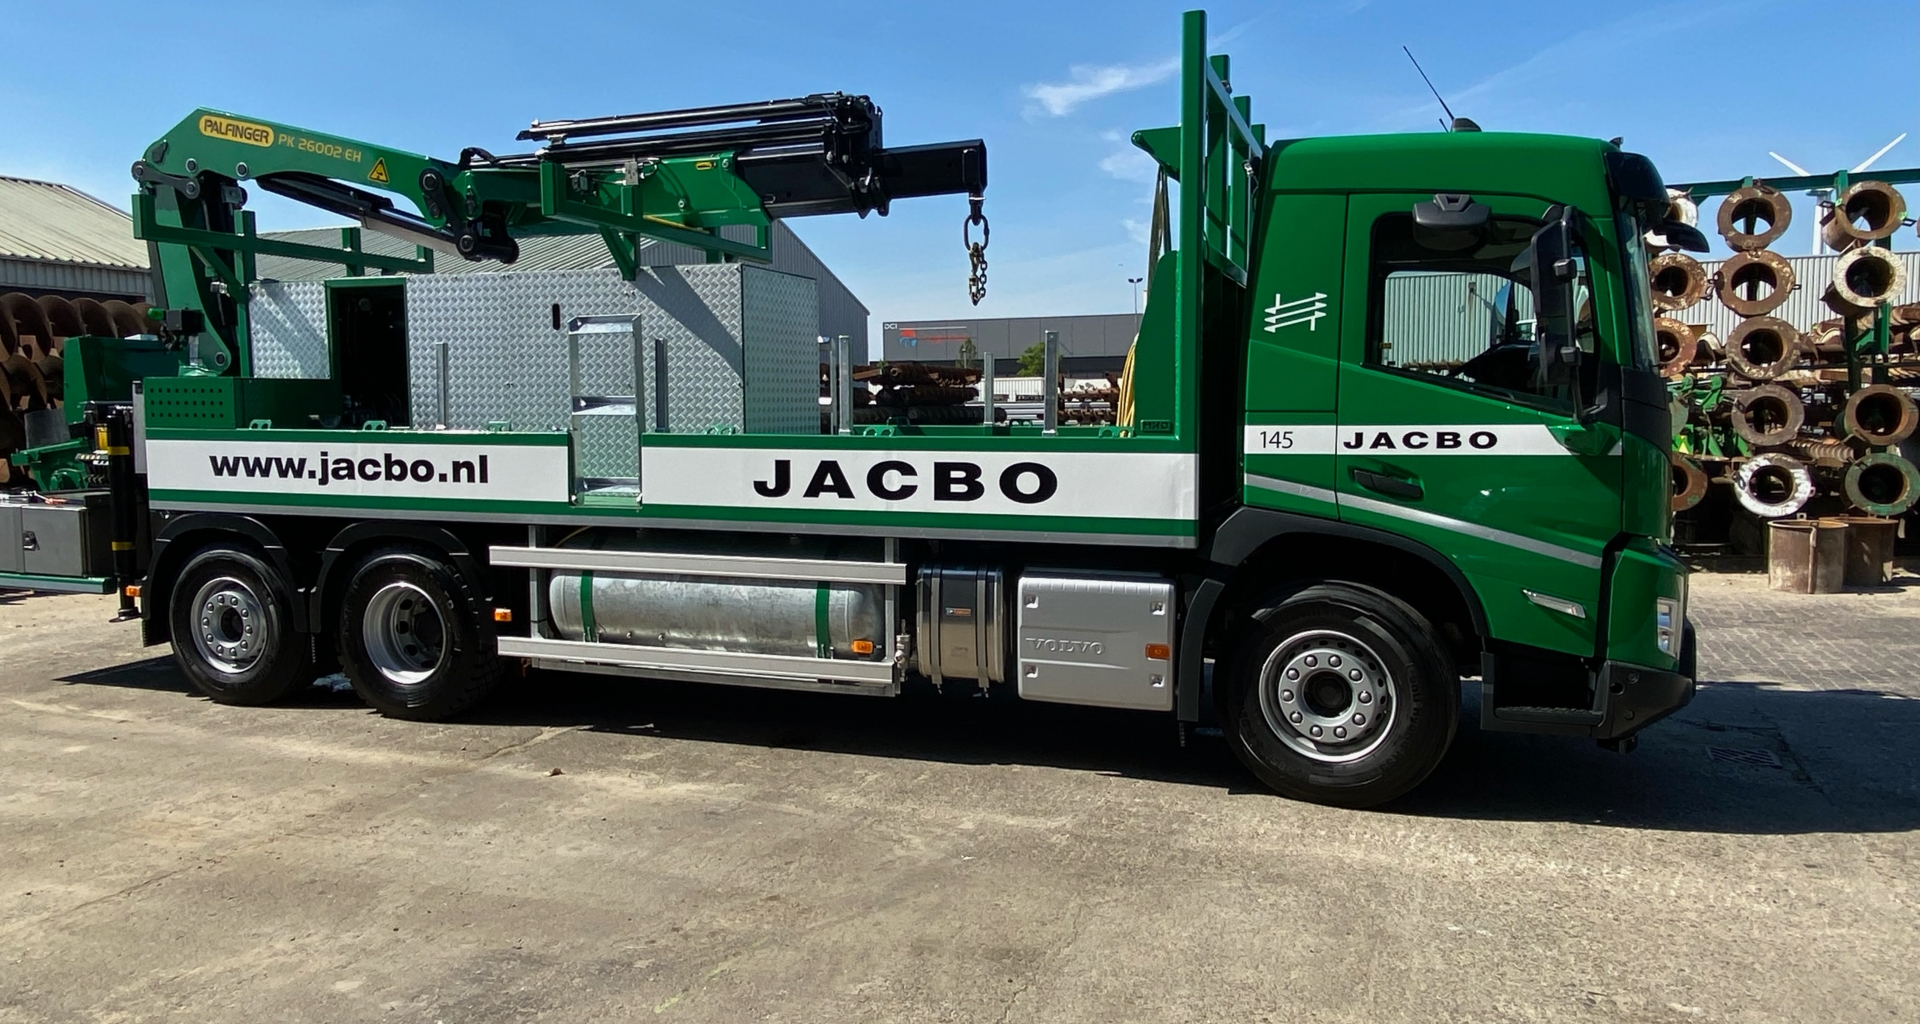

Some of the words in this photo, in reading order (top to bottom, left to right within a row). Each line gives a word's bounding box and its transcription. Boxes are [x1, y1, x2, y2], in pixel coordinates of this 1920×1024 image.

[203, 119, 270, 144] PALFINGER
[278, 133, 295, 148] PK
[298, 138, 342, 159] 26002
[344, 149, 362, 163] EH
[1259, 431, 1294, 449] 145
[1343, 431, 1498, 450] JACBO
[209, 451, 489, 486] www.jacbo.nl
[753, 459, 1058, 504] JACBO
[1025, 637, 1106, 656] VOLVO
